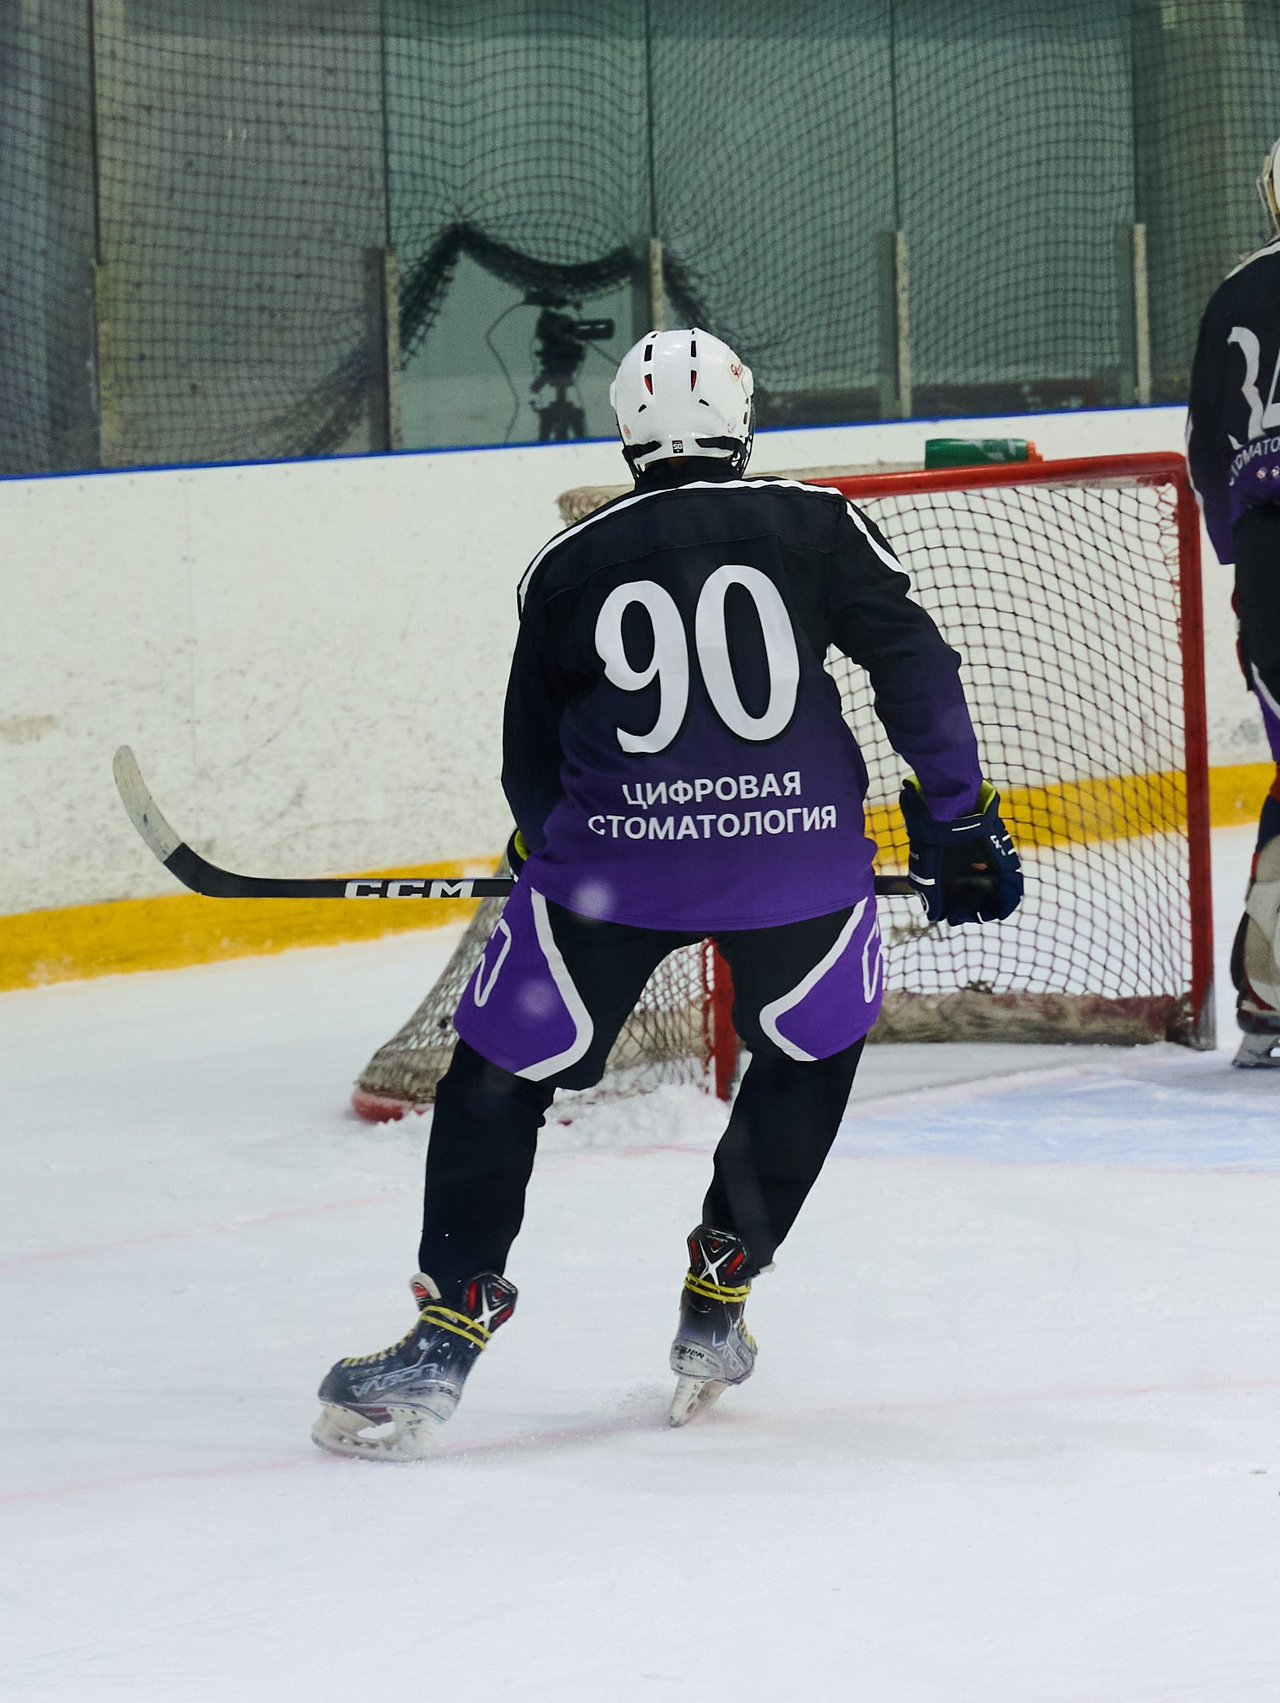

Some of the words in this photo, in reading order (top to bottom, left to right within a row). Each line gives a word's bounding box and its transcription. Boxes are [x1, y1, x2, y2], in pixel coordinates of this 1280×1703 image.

[594, 564, 800, 755] 90
[621, 770, 802, 810] ЦИФРОВАЯ
[587, 804, 837, 841] СТОМАТОЛОГИЯ
[344, 879, 476, 899] CCM
